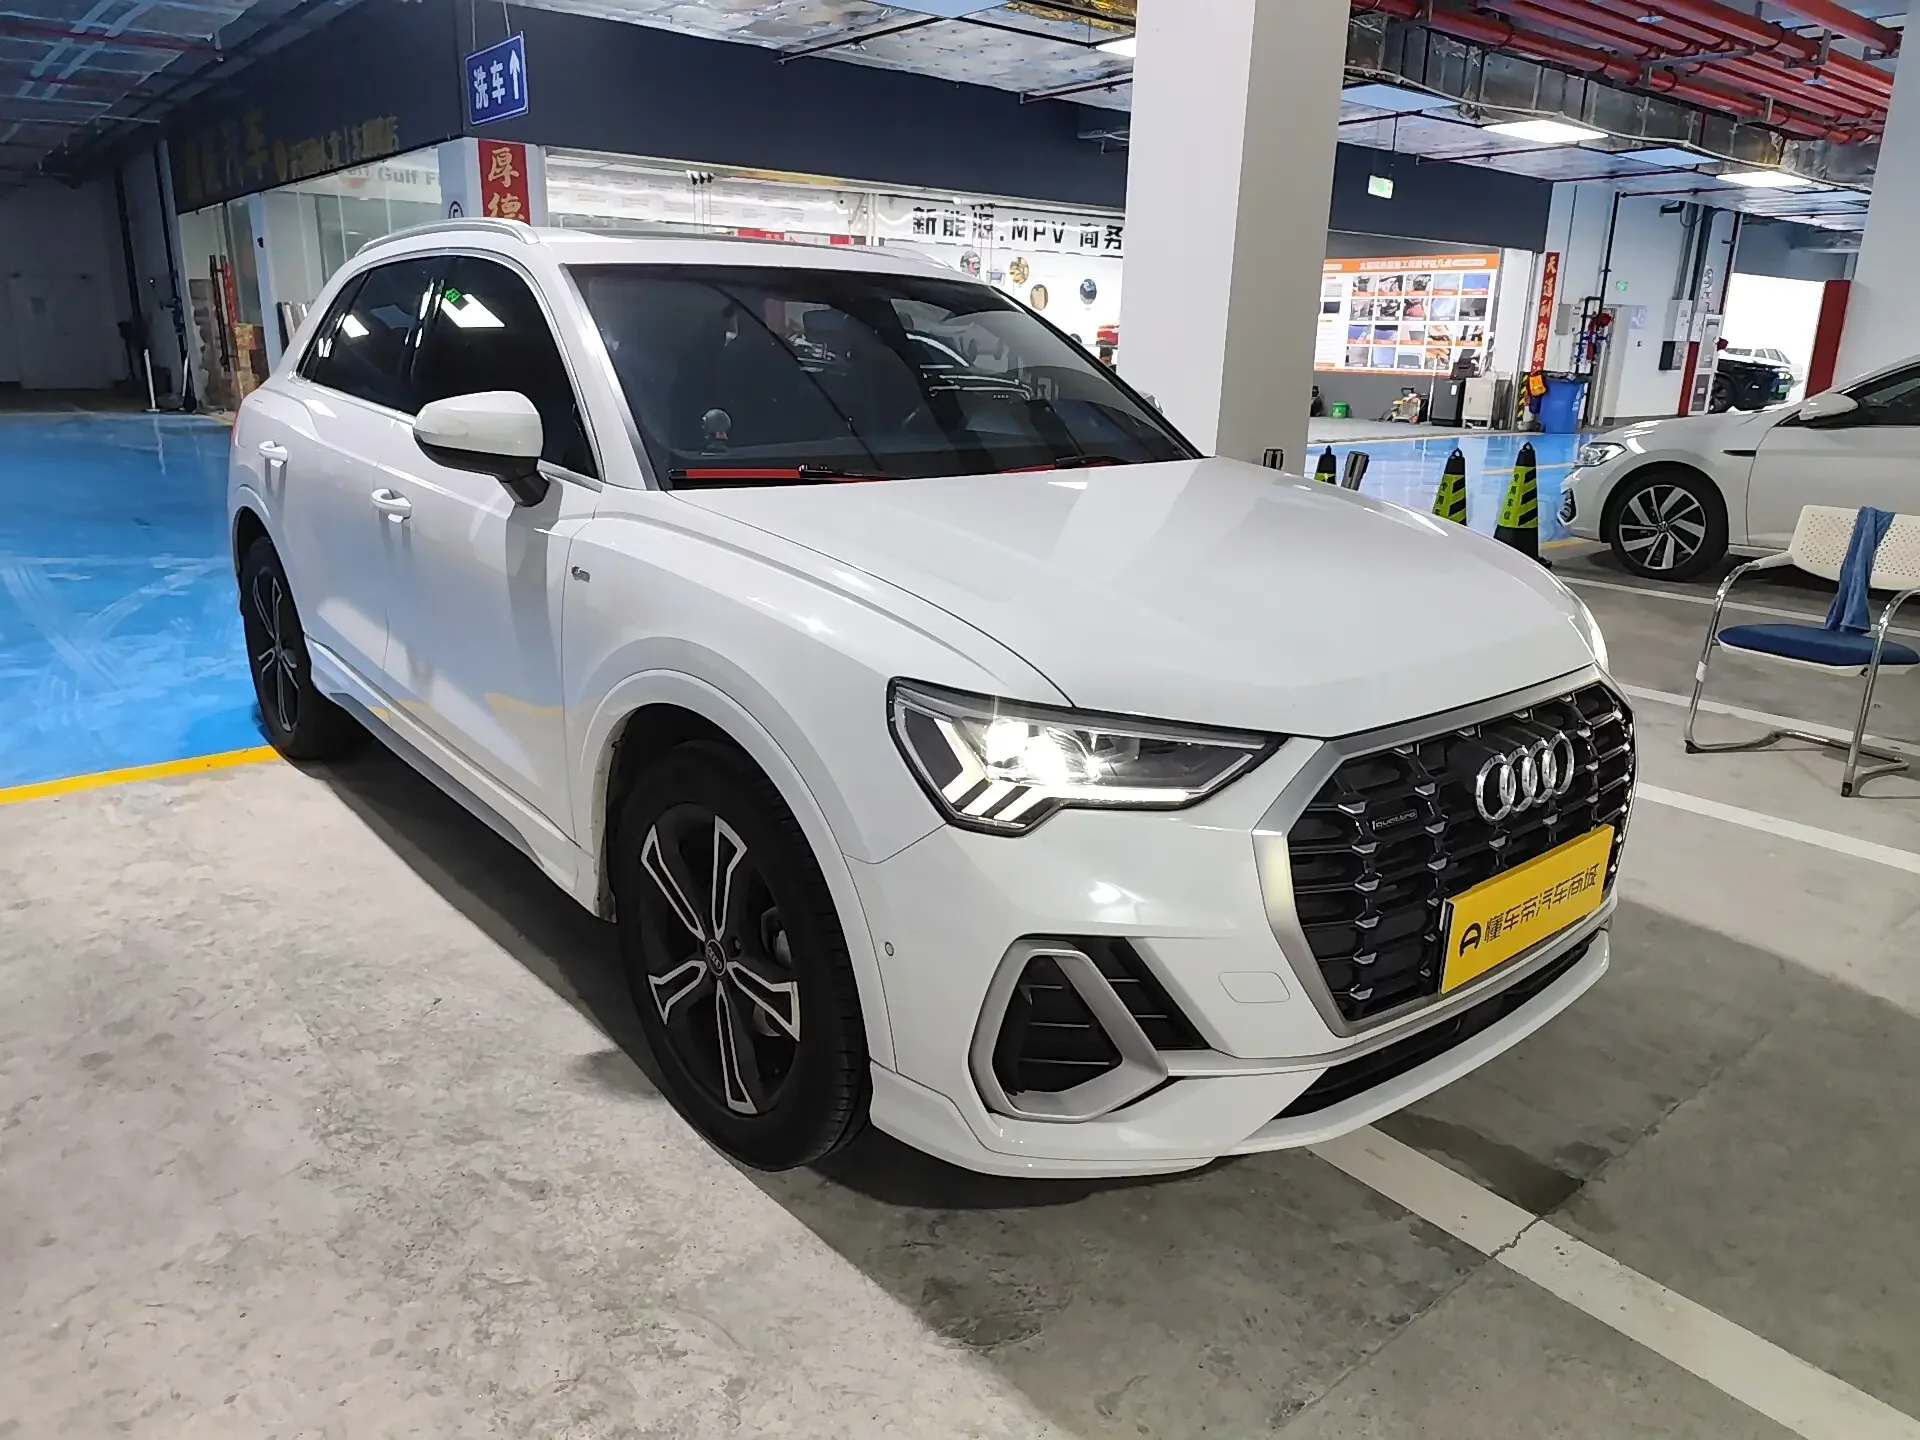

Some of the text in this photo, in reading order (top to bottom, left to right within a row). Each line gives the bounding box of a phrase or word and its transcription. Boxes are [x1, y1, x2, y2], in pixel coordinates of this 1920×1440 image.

[473, 65, 506, 109] 洗车
[378, 167, 418, 184] Gulf
[1484, 863, 1600, 943] 懂车帝汽车商城
